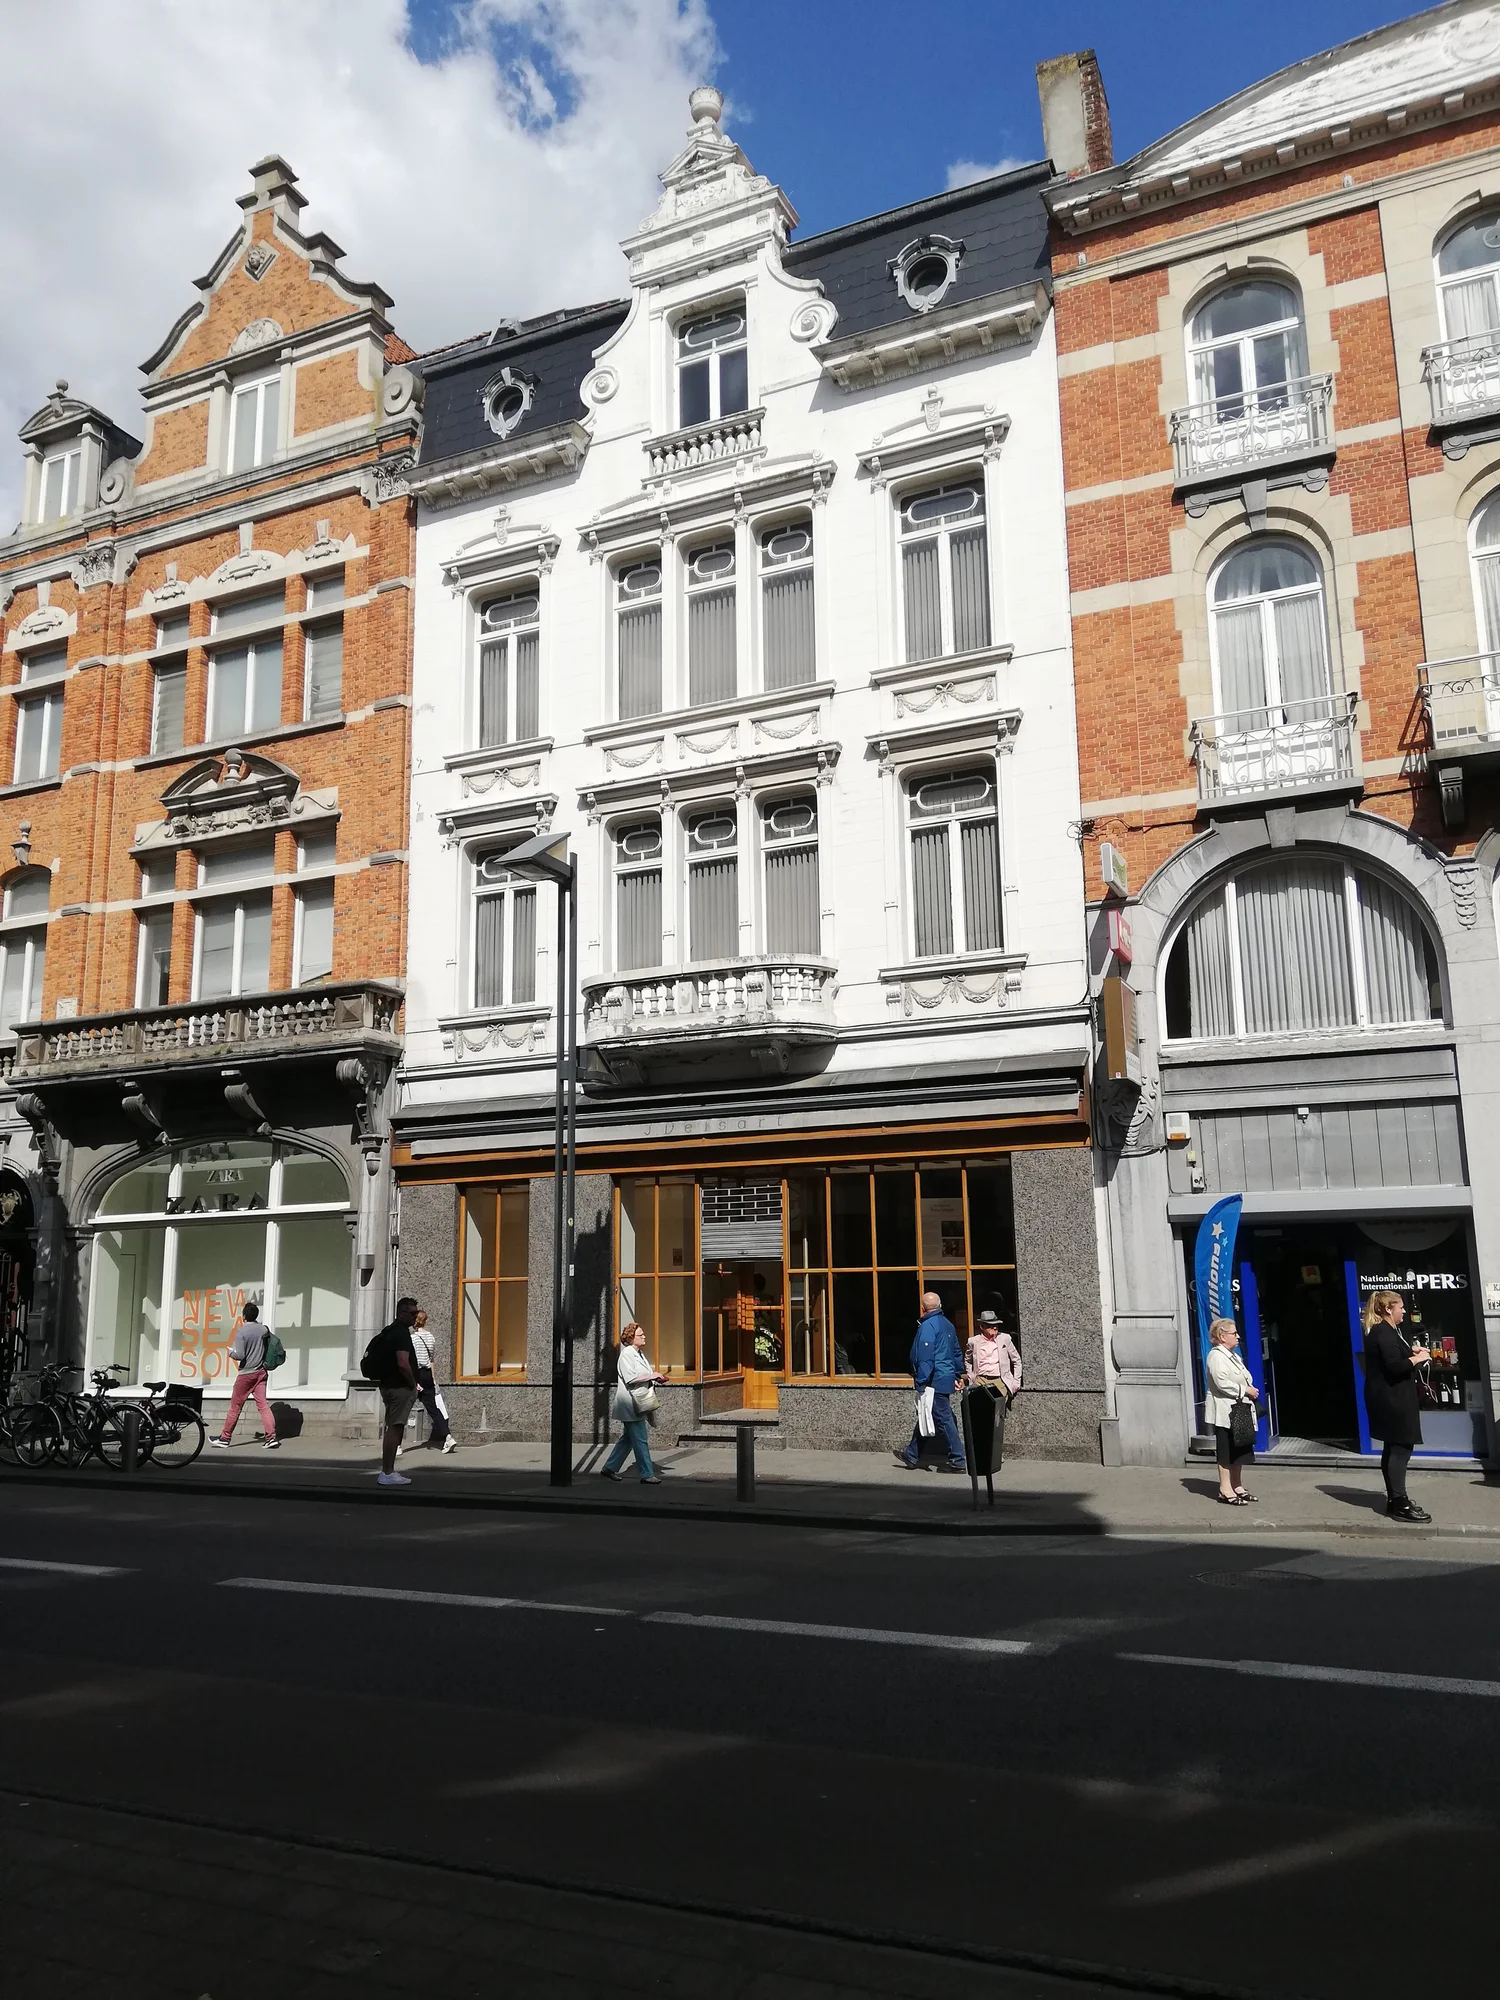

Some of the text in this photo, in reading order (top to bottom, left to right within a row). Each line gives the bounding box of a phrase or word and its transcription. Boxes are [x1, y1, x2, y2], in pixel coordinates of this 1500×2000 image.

[206, 1168, 245, 1184] ZARA
[164, 1192, 271, 1215] ZARA
[1360, 1275, 1403, 1283] Nationale
[1361, 1282, 1415, 1291] Internationale
[1416, 1274, 1468, 1290] PERS
